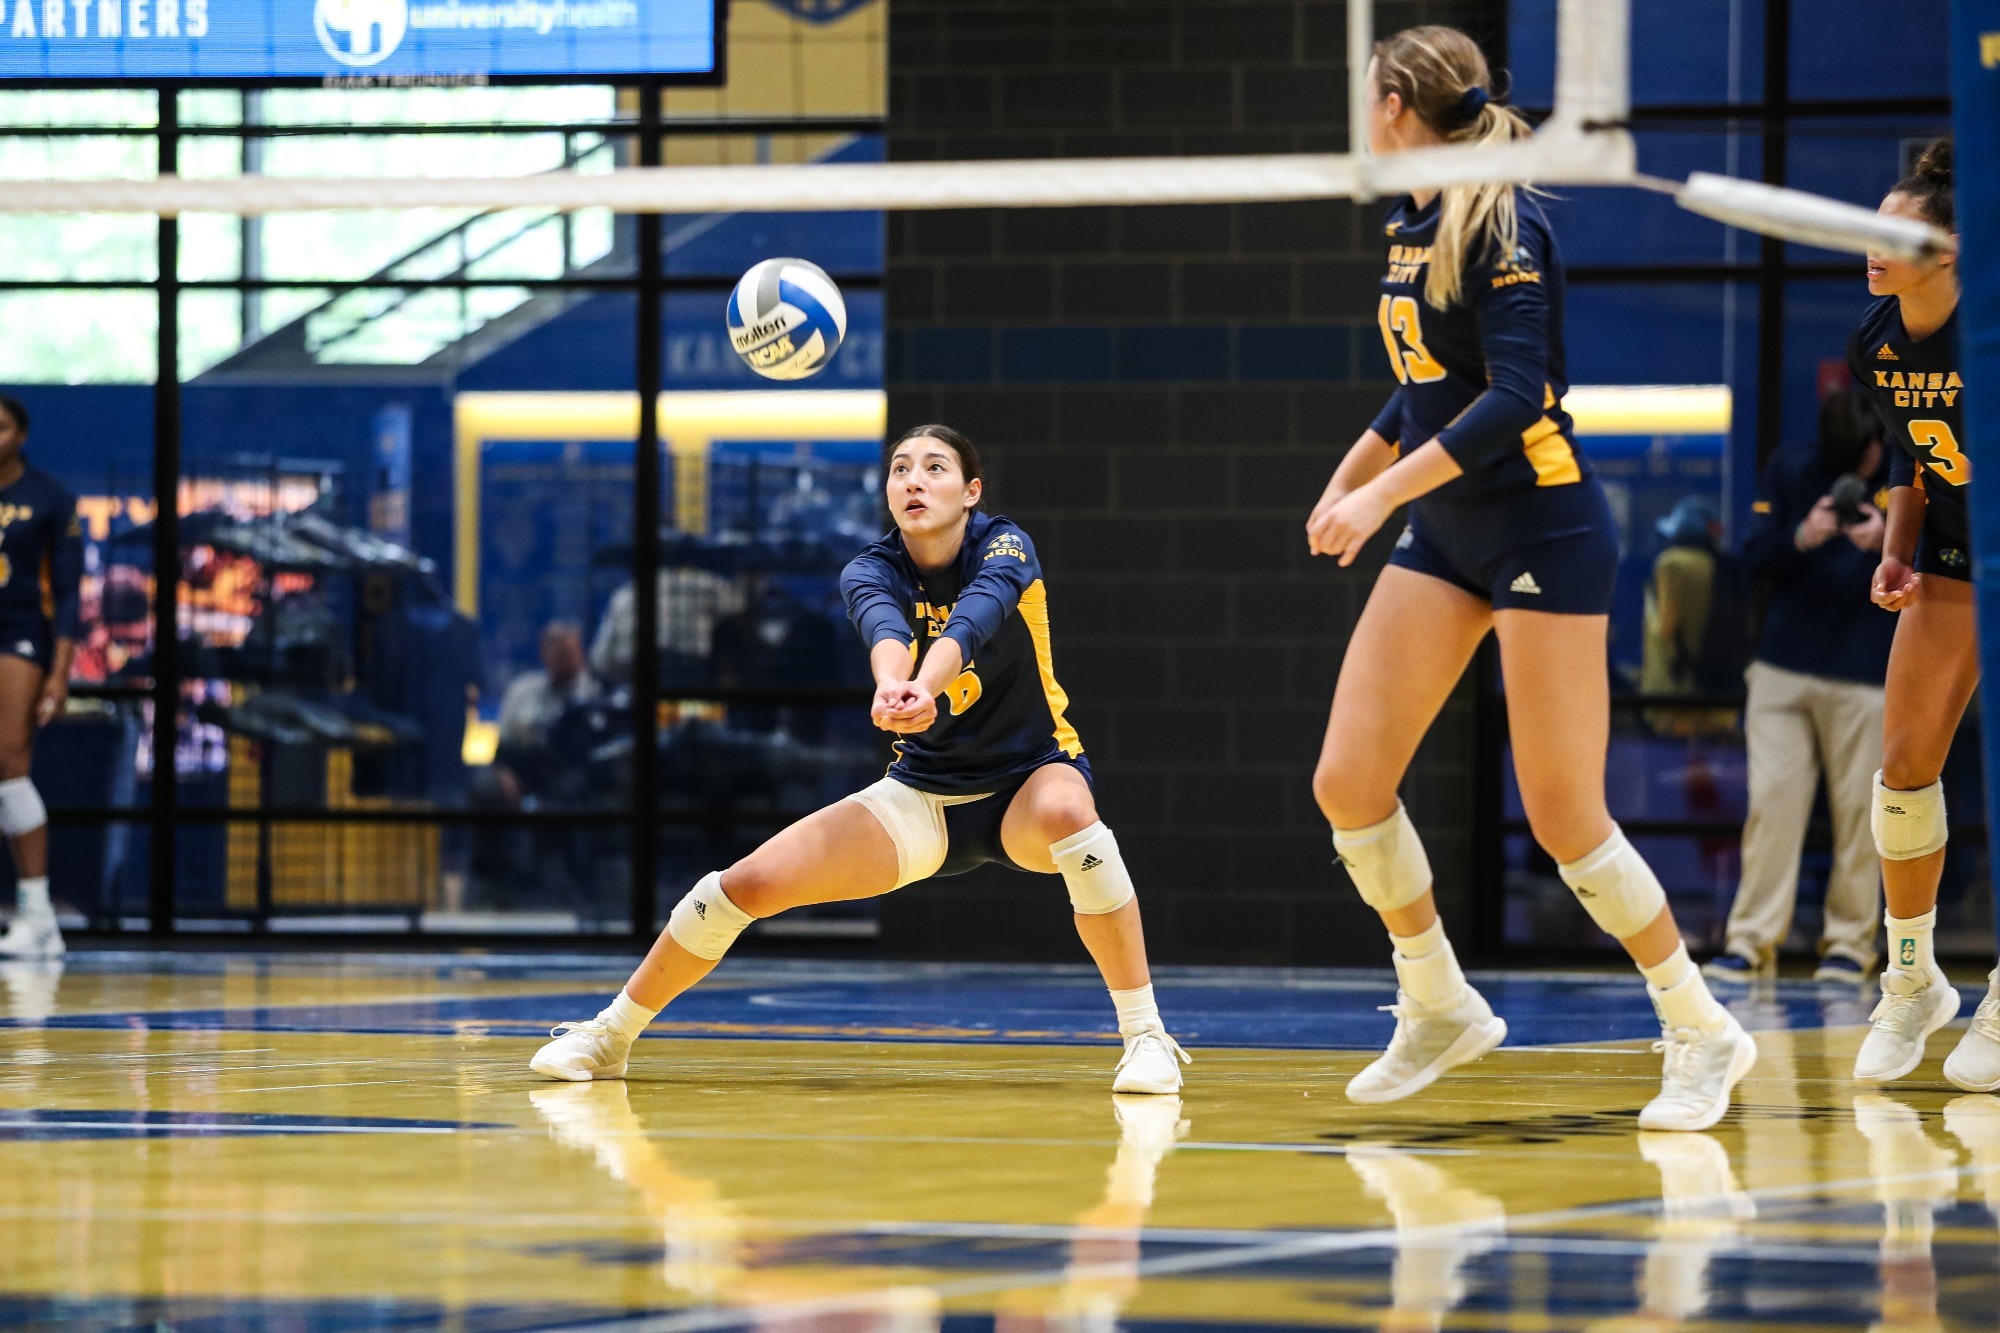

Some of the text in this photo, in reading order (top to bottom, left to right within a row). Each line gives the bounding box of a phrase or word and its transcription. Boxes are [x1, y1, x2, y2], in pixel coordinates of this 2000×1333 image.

[0, 0, 208, 38] ARTNERS
[736, 315, 787, 349] molten
[1378, 293, 1448, 386] 13
[748, 334, 795, 368] NCAA
[1873, 370, 1964, 390] KANSA
[1894, 390, 1959, 408] CITY
[1907, 419, 1972, 486] 3
